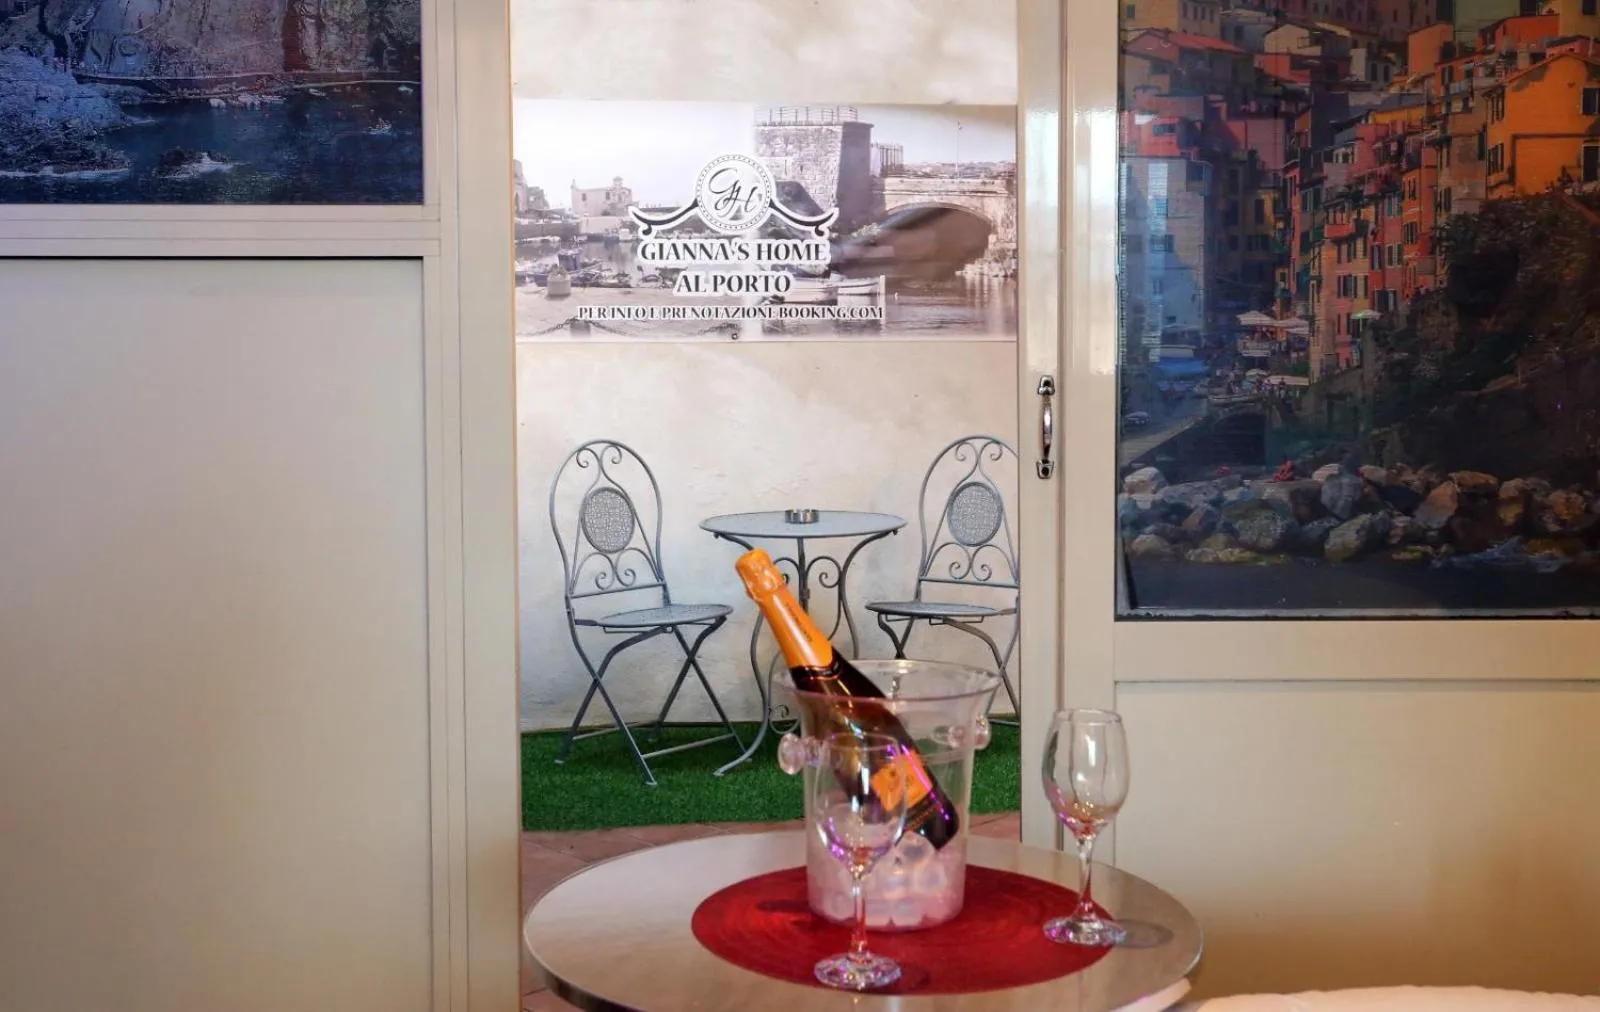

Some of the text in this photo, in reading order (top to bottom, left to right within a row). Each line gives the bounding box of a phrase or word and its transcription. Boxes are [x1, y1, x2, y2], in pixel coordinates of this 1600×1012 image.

[640, 241, 826, 261] GIANNA'S HOME
[676, 274, 791, 293] AL PORTO
[578, 306, 607, 319] PER
[611, 306, 647, 319] INFO
[662, 306, 777, 319] PRENOTAZIONE
[779, 306, 884, 319] BOOKING.COM
